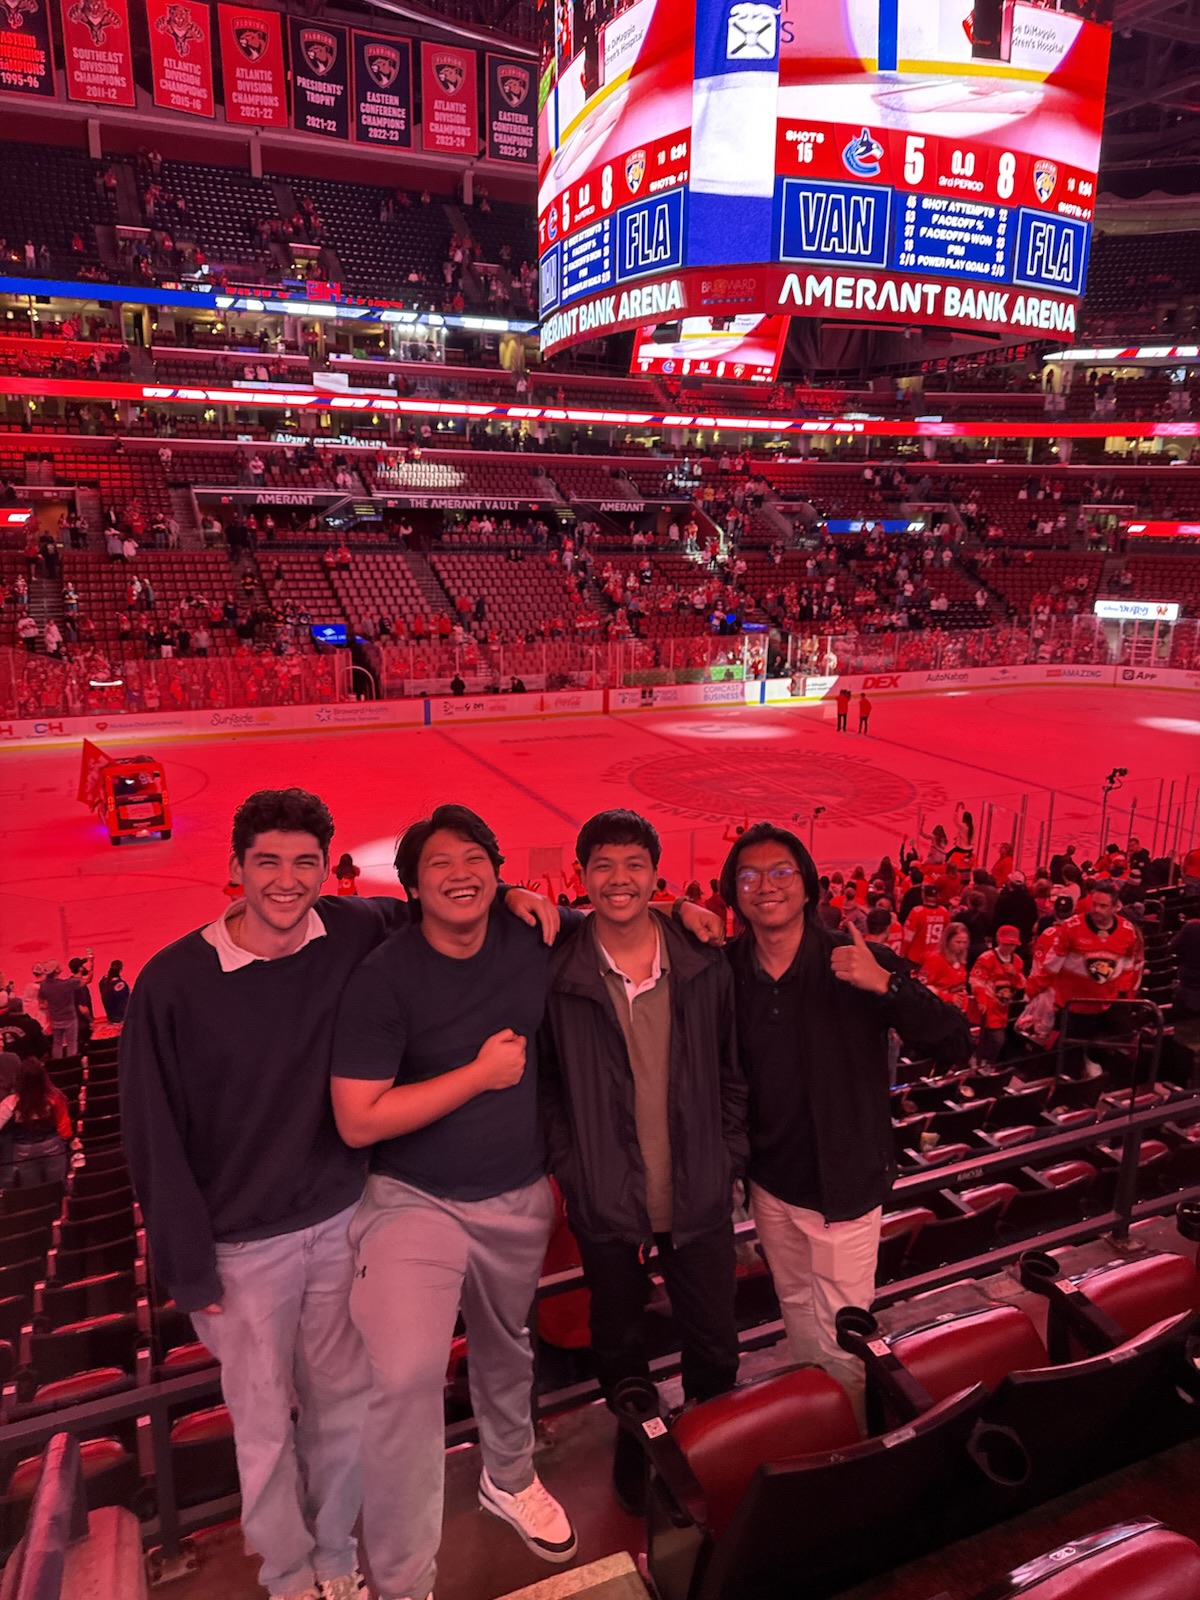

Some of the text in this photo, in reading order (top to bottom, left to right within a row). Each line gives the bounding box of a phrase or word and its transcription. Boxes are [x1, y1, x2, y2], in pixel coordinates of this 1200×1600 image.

[0, 31, 36, 48] ASTERN
[0, 45, 45, 62] NFERENCE
[72, 47, 124, 64] SOUTHEAST
[80, 60, 119, 75] DIVISION
[164, 57, 202, 75] ATLANTIC
[235, 67, 273, 81] ATLANTIC
[1, 72, 39, 88] 1995-96
[73, 70, 127, 87] CHAMPIONS
[165, 68, 200, 86] DIVISION
[86, 85, 117, 99] 2011-12
[159, 78, 208, 99] CHAMPIONS
[237, 80, 272, 94] DIVISION
[296, 76, 343, 95] PRESIDENTS'
[170, 94, 202, 110] 2015-16
[232, 92, 279, 107] CHAMPIONS
[305, 91, 335, 107] TROPHY
[367, 91, 399, 106] EASTERN
[434, 100, 467, 113] ATLANTIC
[240, 106, 273, 119] 2021-22
[360, 102, 406, 118] CONFERENCE
[434, 111, 466, 124] DIVISION
[498, 111, 529, 124] EASTERN
[306, 115, 337, 131] 2021-22
[361, 115, 405, 130] CHAMPIONS
[429, 122, 471, 137] CHAMPIONS
[492, 121, 534, 136] CONFERENCE
[368, 127, 399, 141] 2022-23
[435, 135, 465, 147] 2023-24
[493, 133, 533, 148] CHAMPIONS
[785, 130, 825, 144] SHOTS
[499, 145, 528, 158] 2023-24
[903, 135, 926, 185] 5
[951, 150, 975, 177] 0.0
[997, 152, 1016, 199] 8
[602, 165, 613, 209] 8
[953, 178, 984, 192] PERIOD
[562, 190, 570, 232] 5
[922, 197, 995, 220] SHOT ATTEMPTS
[799, 191, 875, 255] VAN
[931, 213, 976, 230] FACEOFF
[625, 203, 671, 269] FLA
[919, 227, 993, 247] FACEOFFS WON
[947, 244, 966, 257] PIM
[1026, 220, 1074, 283] FLA
[917, 254, 990, 274] POWER PLAY GOALS
[580, 295, 616, 332] BANK
[618, 280, 683, 321] ARENA
[778, 273, 1077, 333] AMERANT BANK ARENA
[255, 494, 315, 505] AMERANT
[409, 499, 520, 511] THE AMERANT VAULT
[600, 503, 646, 512] AMERANT
[862, 675, 902, 690] DEX
[926, 673, 969, 682] AutoNation
[703, 684, 739, 693] COMCAST
[703, 693, 739, 701] BUSINESS
[925, 923, 944, 945] 19
